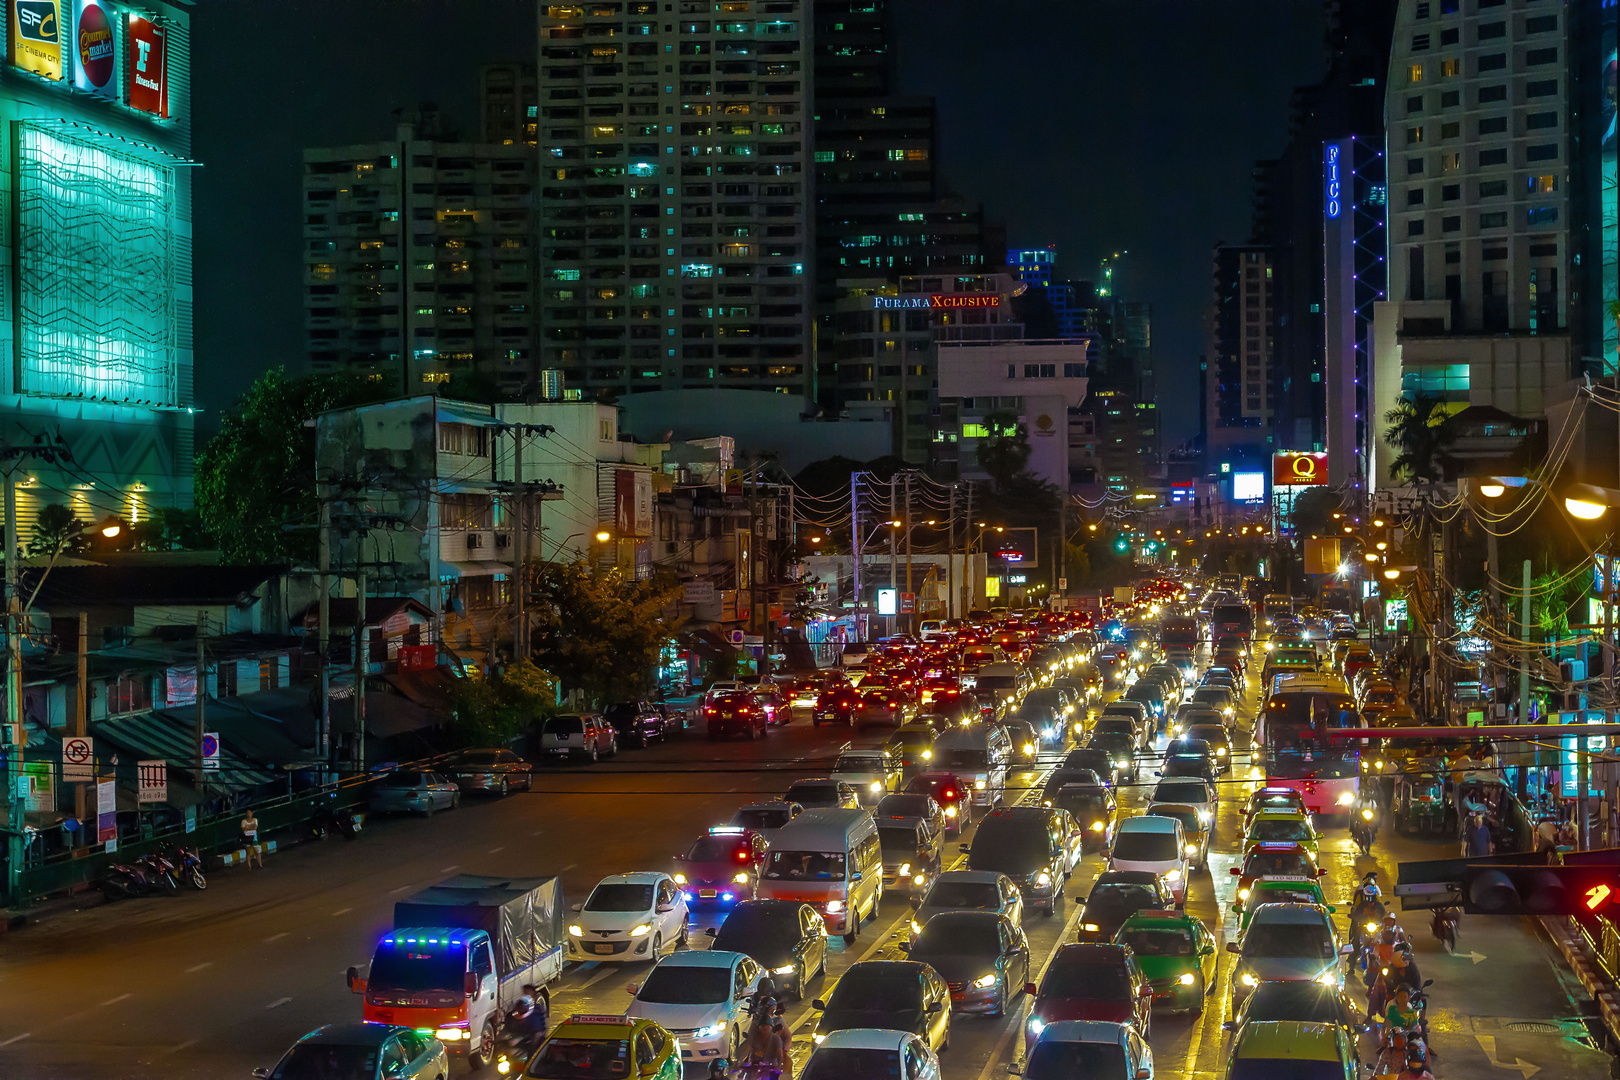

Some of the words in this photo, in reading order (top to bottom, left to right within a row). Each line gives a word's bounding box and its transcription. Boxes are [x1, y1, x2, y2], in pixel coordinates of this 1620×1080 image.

[25, 45, 47, 60] CINEMA
[47, 54, 60, 65] CITY
[89, 39, 113, 57] market
[1327, 145, 1339, 217] FICO
[1292, 456, 1317, 477] Q
[397, 998, 429, 1006] ISUZU
